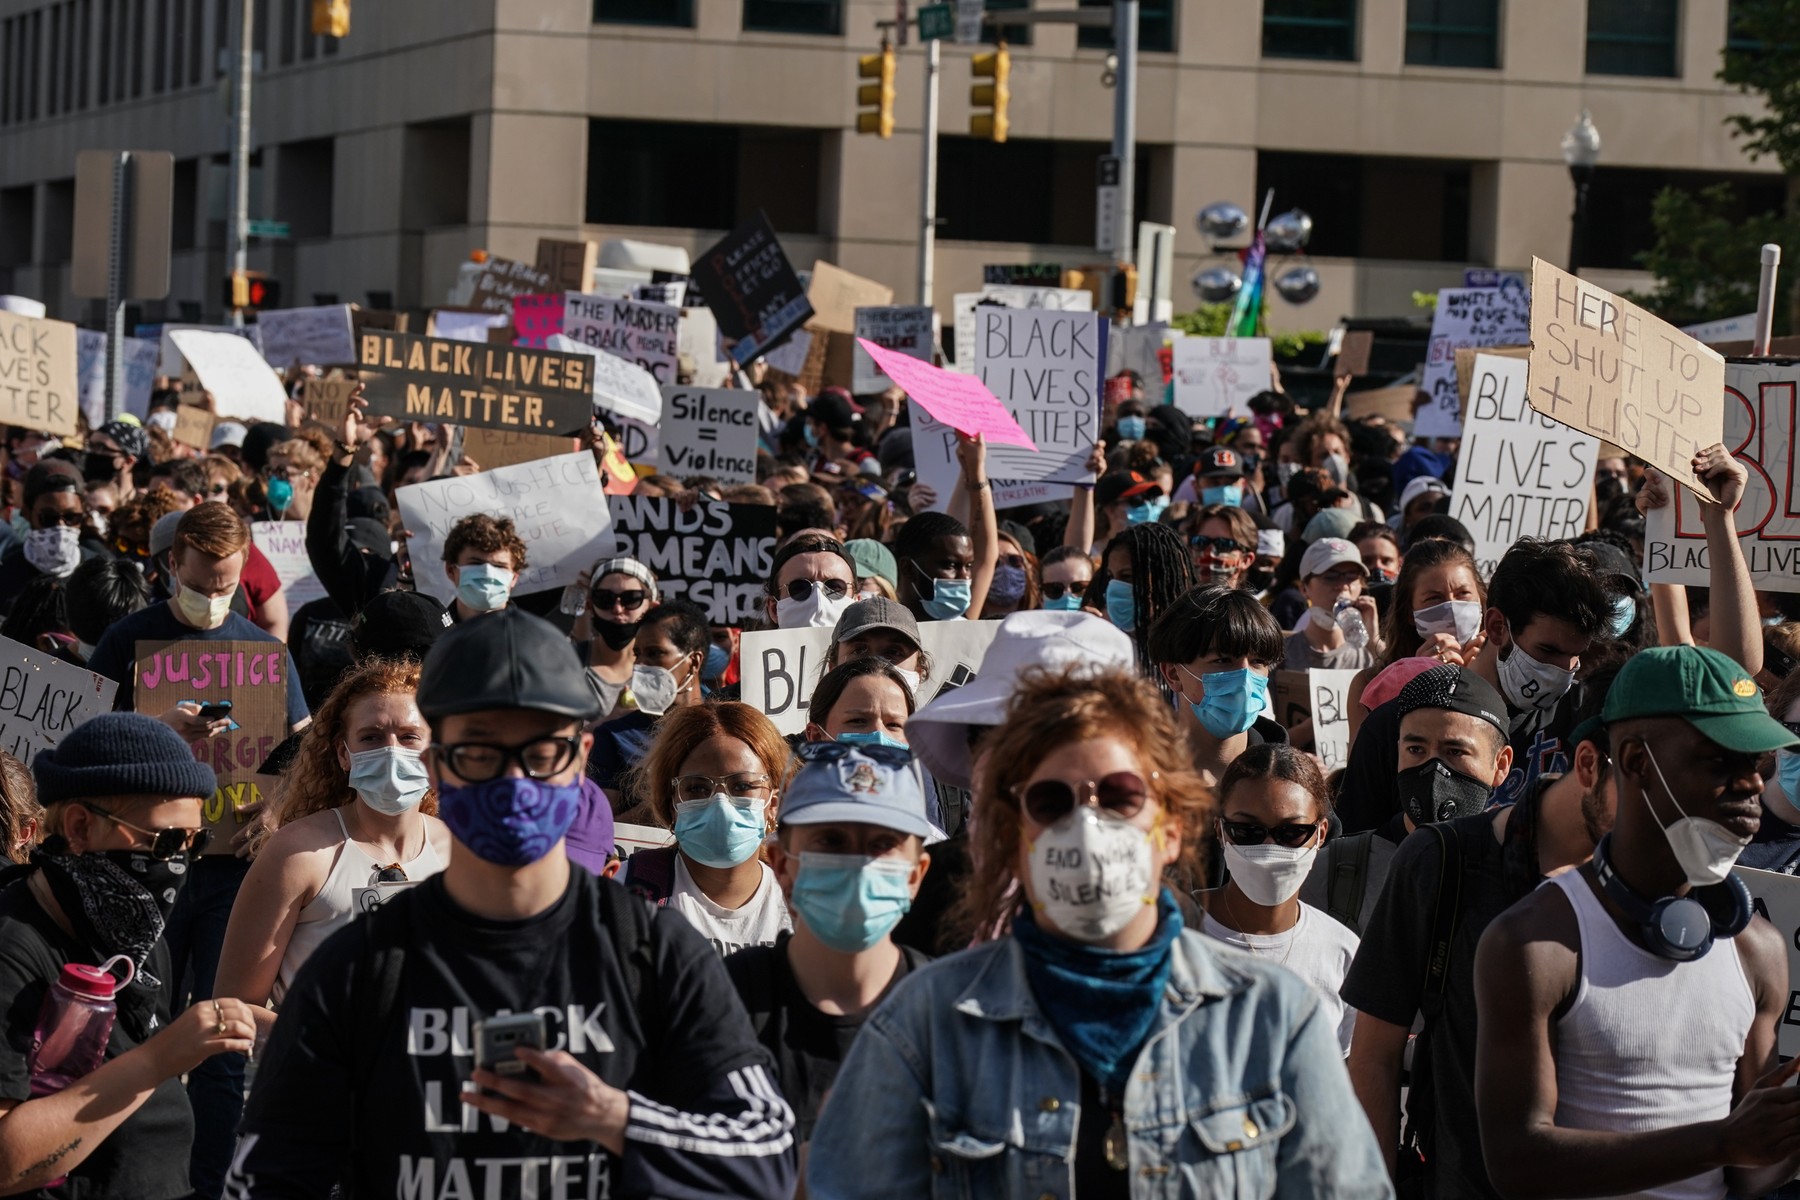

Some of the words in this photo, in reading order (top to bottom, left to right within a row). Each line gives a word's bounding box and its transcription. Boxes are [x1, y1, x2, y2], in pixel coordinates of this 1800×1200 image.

[569, 300, 605, 320] THE
[613, 303, 677, 334] MURDER
[986, 313, 1095, 360] BLACK
[1555, 278, 1642, 352] HERE
[1660, 334, 1700, 381] TO
[361, 334, 473, 376] BLACK
[584, 325, 634, 354] BLACK
[1546, 322, 1645, 394] SHUT
[1655, 379, 1702, 424] UP
[405, 383, 556, 428] MATTER.
[672, 394, 753, 426] Silence
[665, 445, 754, 474] Violence
[1465, 434, 1587, 489] LIVES
[419, 483, 474, 514] NO
[609, 495, 733, 537] ANDS
[1459, 493, 1585, 543] MATTER
[268, 537, 308, 556] NAM
[637, 532, 778, 579] MEANS
[1648, 541, 1712, 573] BLAC
[141, 652, 282, 690] JUSTICE
[0, 666, 83, 732] BLACK
[191, 735, 275, 774] ORGE
[1045, 847, 1082, 869] END
[407, 1002, 616, 1057] BLCK
